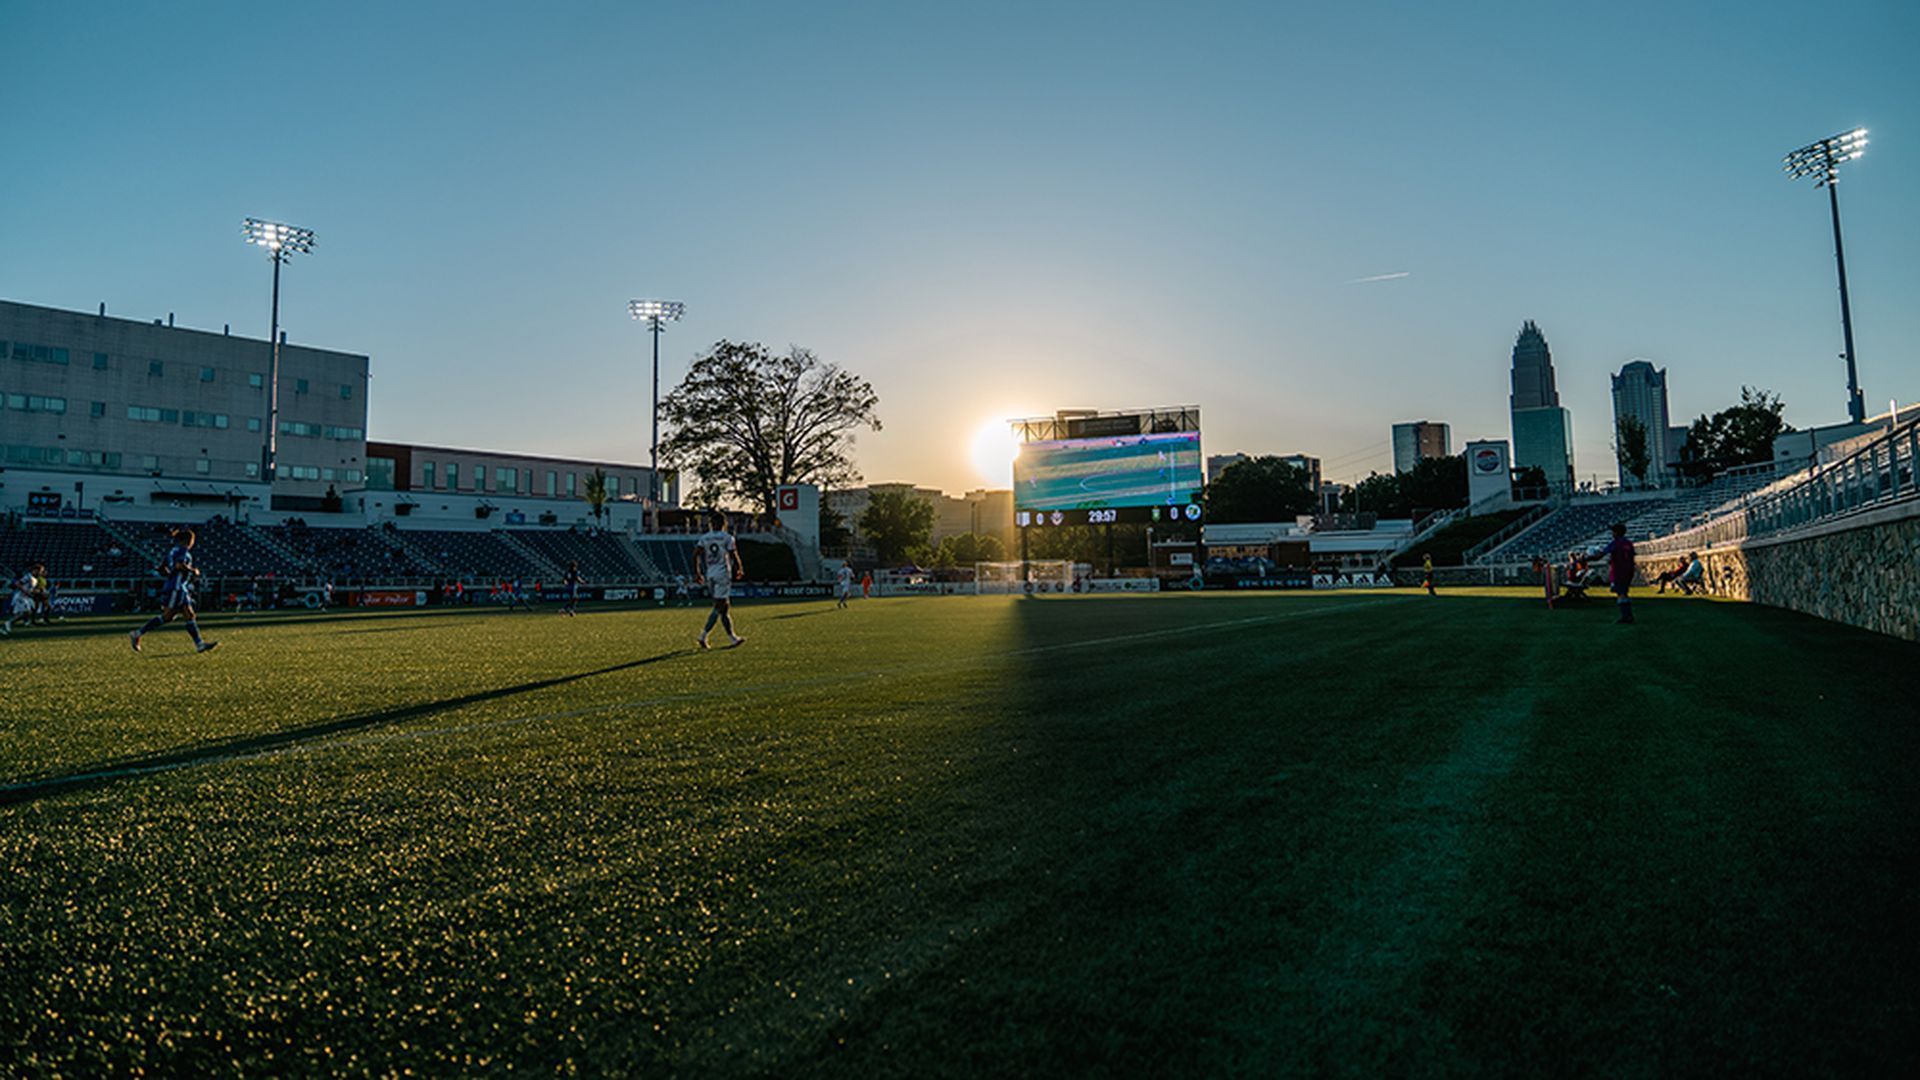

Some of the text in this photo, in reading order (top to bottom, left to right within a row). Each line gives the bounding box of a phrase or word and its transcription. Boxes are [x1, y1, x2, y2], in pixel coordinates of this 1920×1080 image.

[783, 493, 794, 507] G
[1036, 512, 1044, 525] 0
[1170, 507, 1178, 520] 0
[709, 543, 719, 558] 9
